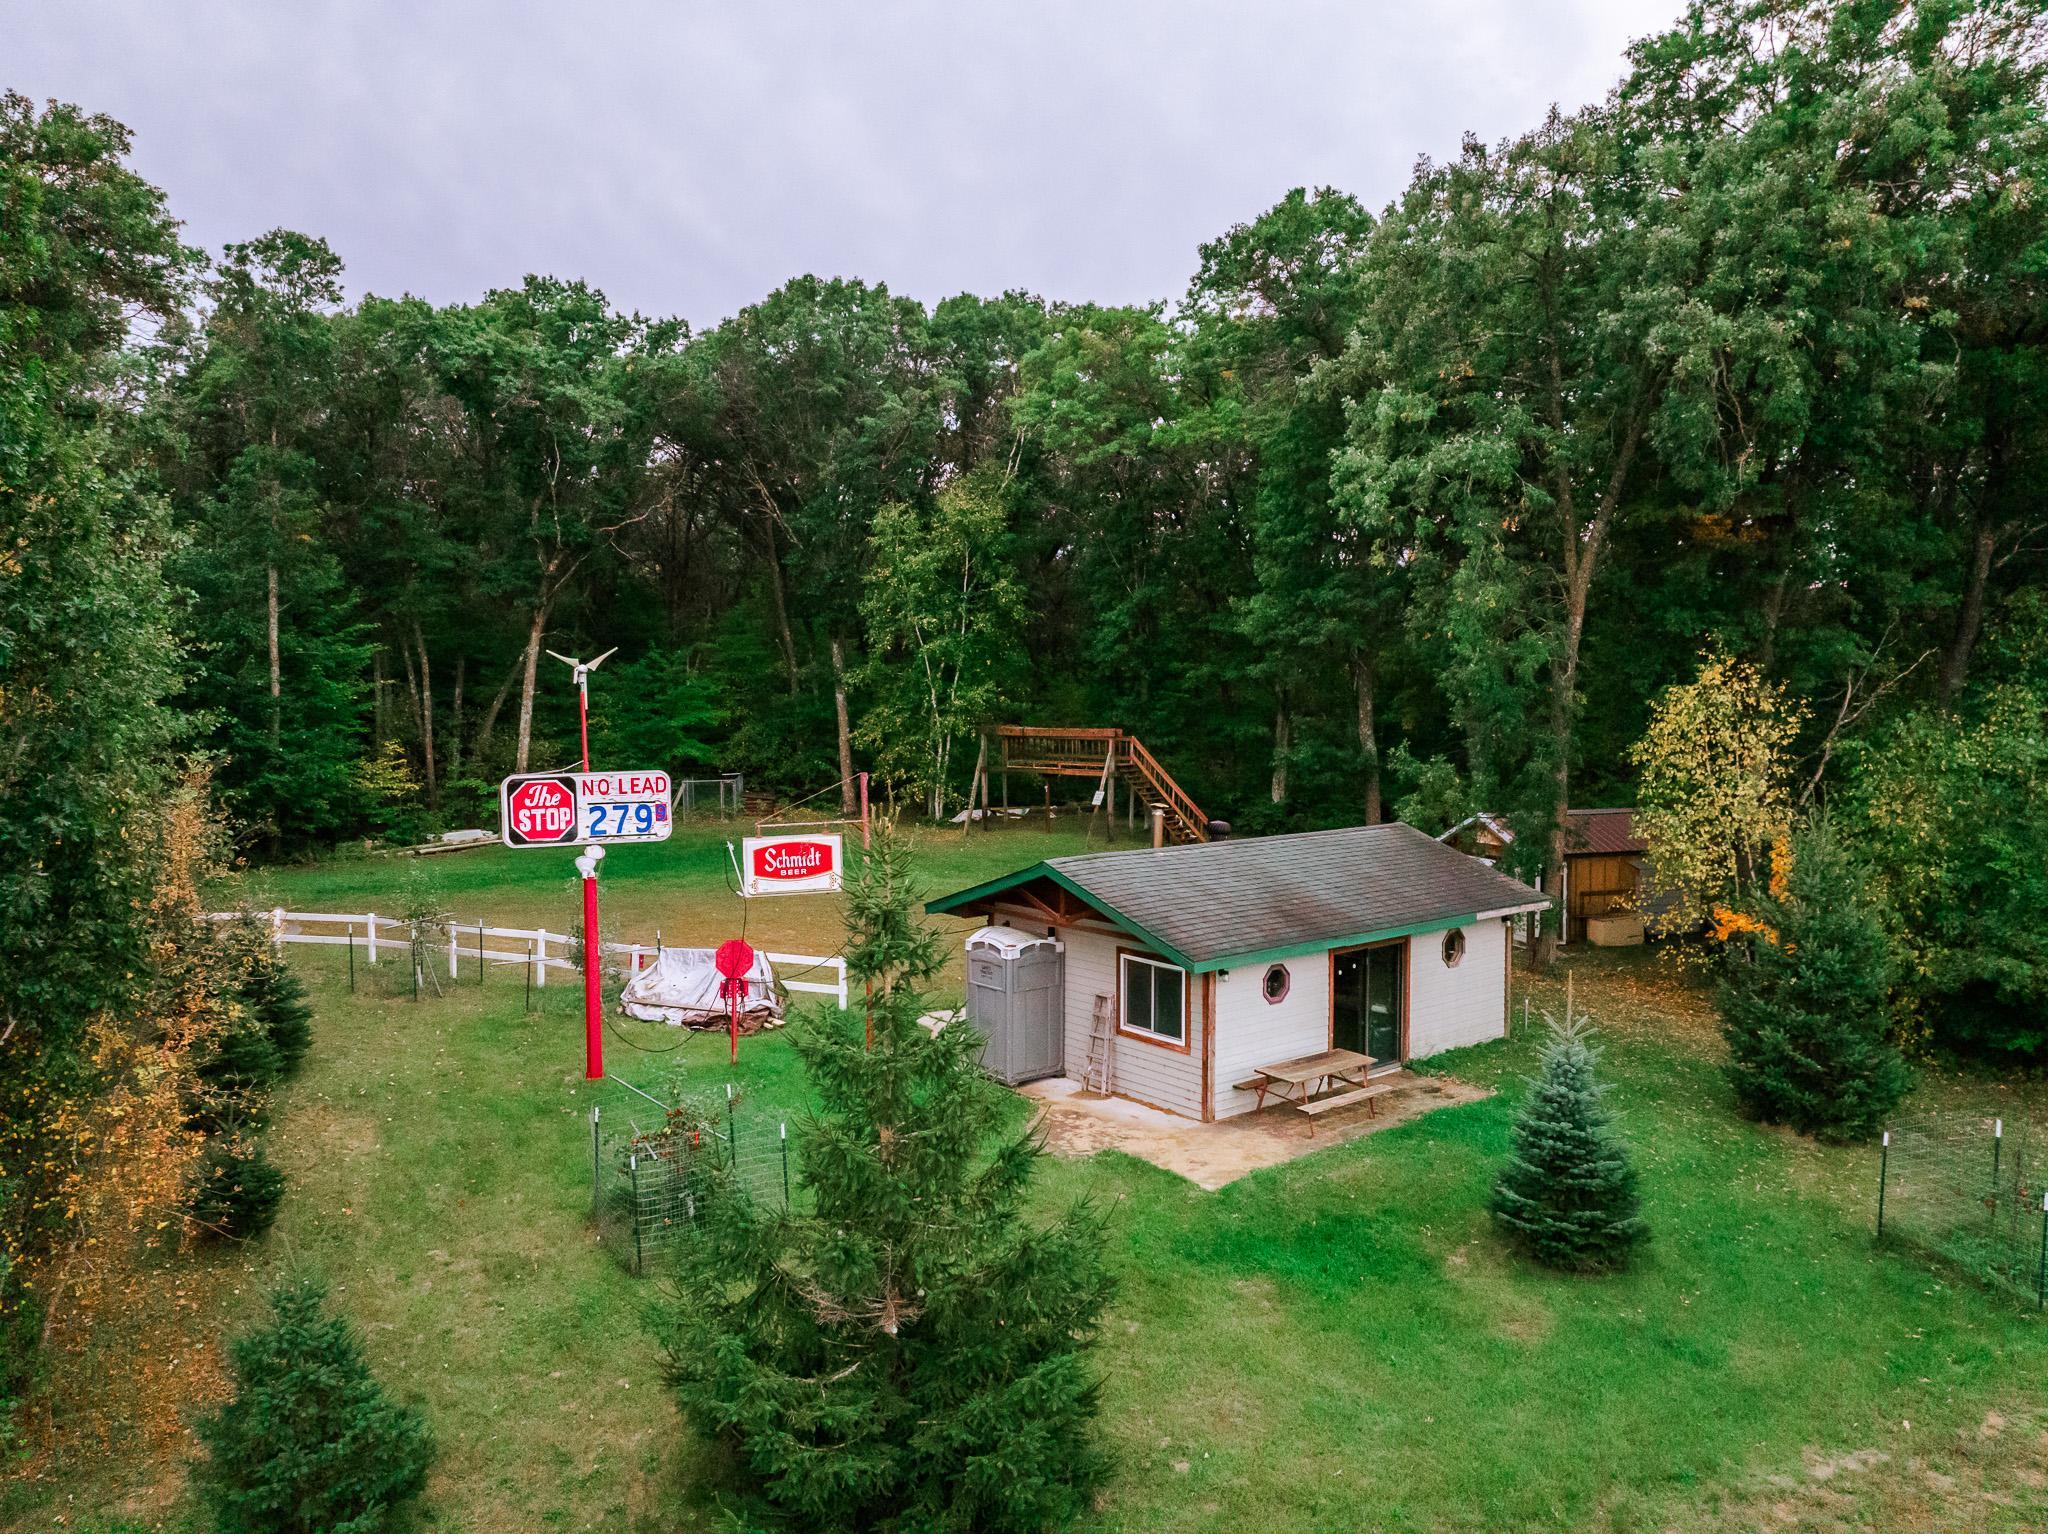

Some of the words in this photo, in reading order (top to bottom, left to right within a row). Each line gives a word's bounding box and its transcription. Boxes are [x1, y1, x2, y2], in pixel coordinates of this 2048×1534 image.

[524, 784, 560, 807] The
[582, 778, 610, 796] NO
[618, 776, 667, 794] LEAD
[518, 808, 571, 832] STOP
[764, 847, 821, 872] Schmidt
[780, 868, 807, 876] BEER
